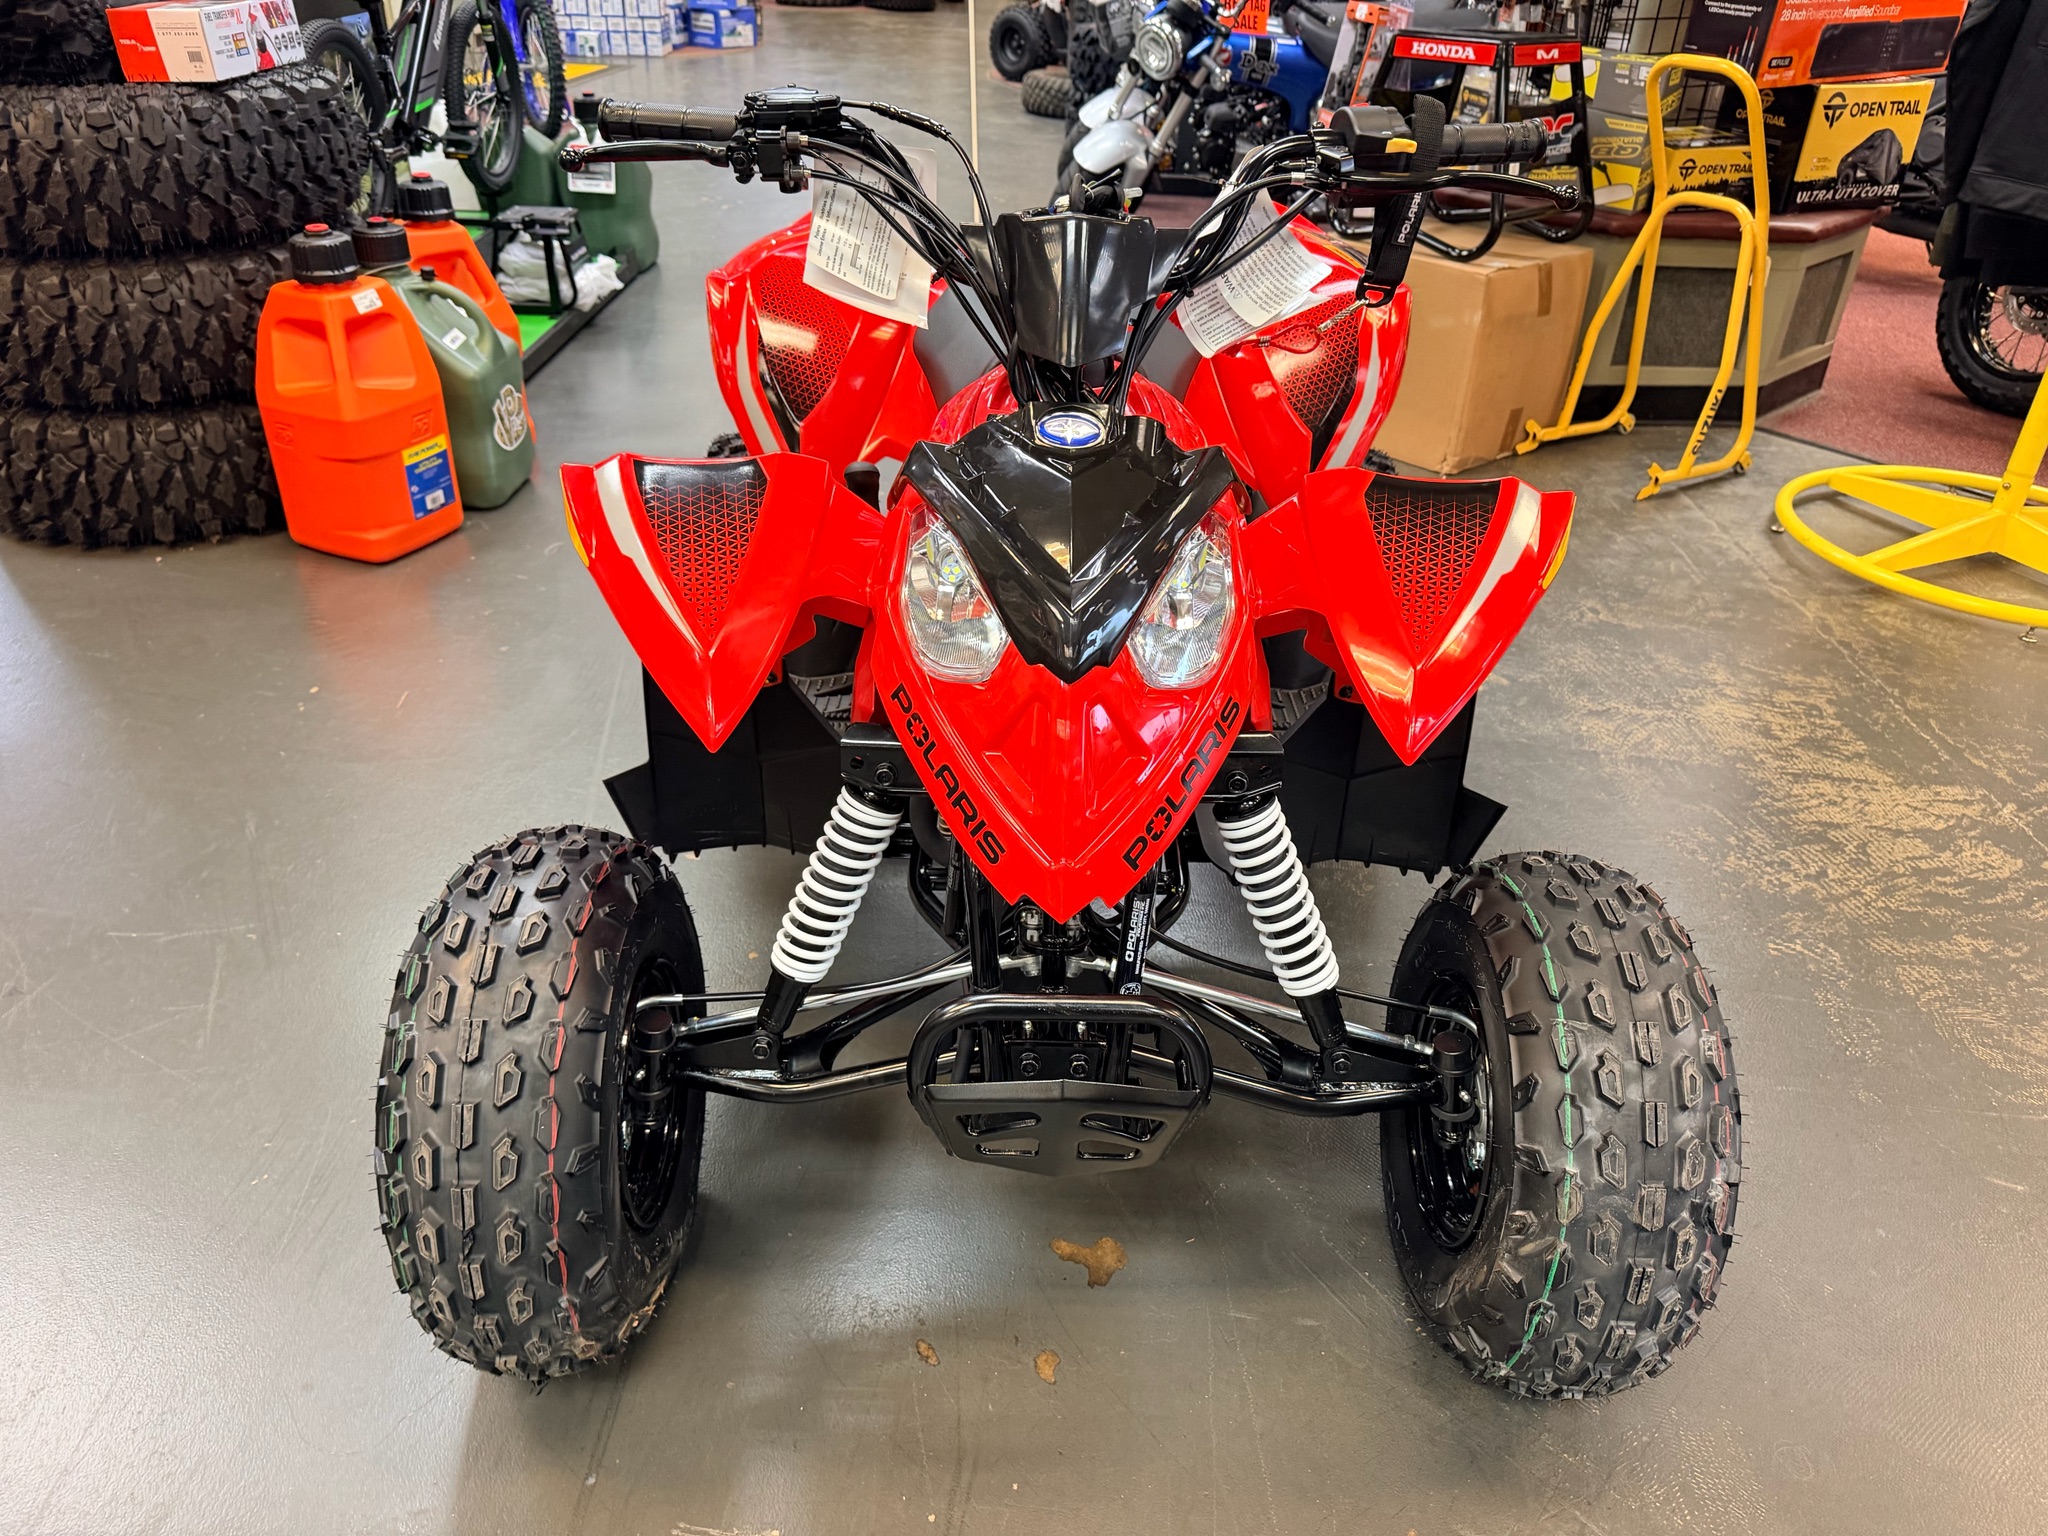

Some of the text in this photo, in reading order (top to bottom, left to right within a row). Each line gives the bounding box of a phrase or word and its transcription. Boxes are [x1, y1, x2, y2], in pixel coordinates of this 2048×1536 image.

[1780, 9, 1792, 20] 28
[1792, 9, 1806, 20] inch
[1843, 6, 1874, 19] Amplified
[1411, 41, 1476, 60] HONDA
[1850, 100, 1921, 119] OPEN TRAIL
[1762, 113, 1787, 127] TRAIL
[1698, 164, 1728, 175] OPEN
[1796, 189, 1835, 204] ULTRA
[1834, 187, 1862, 200] UTV
[1861, 184, 1899, 198] COVER
[1692, 389, 1722, 455] SUZUKI
[890, 682, 1006, 866] POLARIS
[1122, 695, 1241, 872] POLARIS
[1126, 900, 1142, 950] POLARIS
